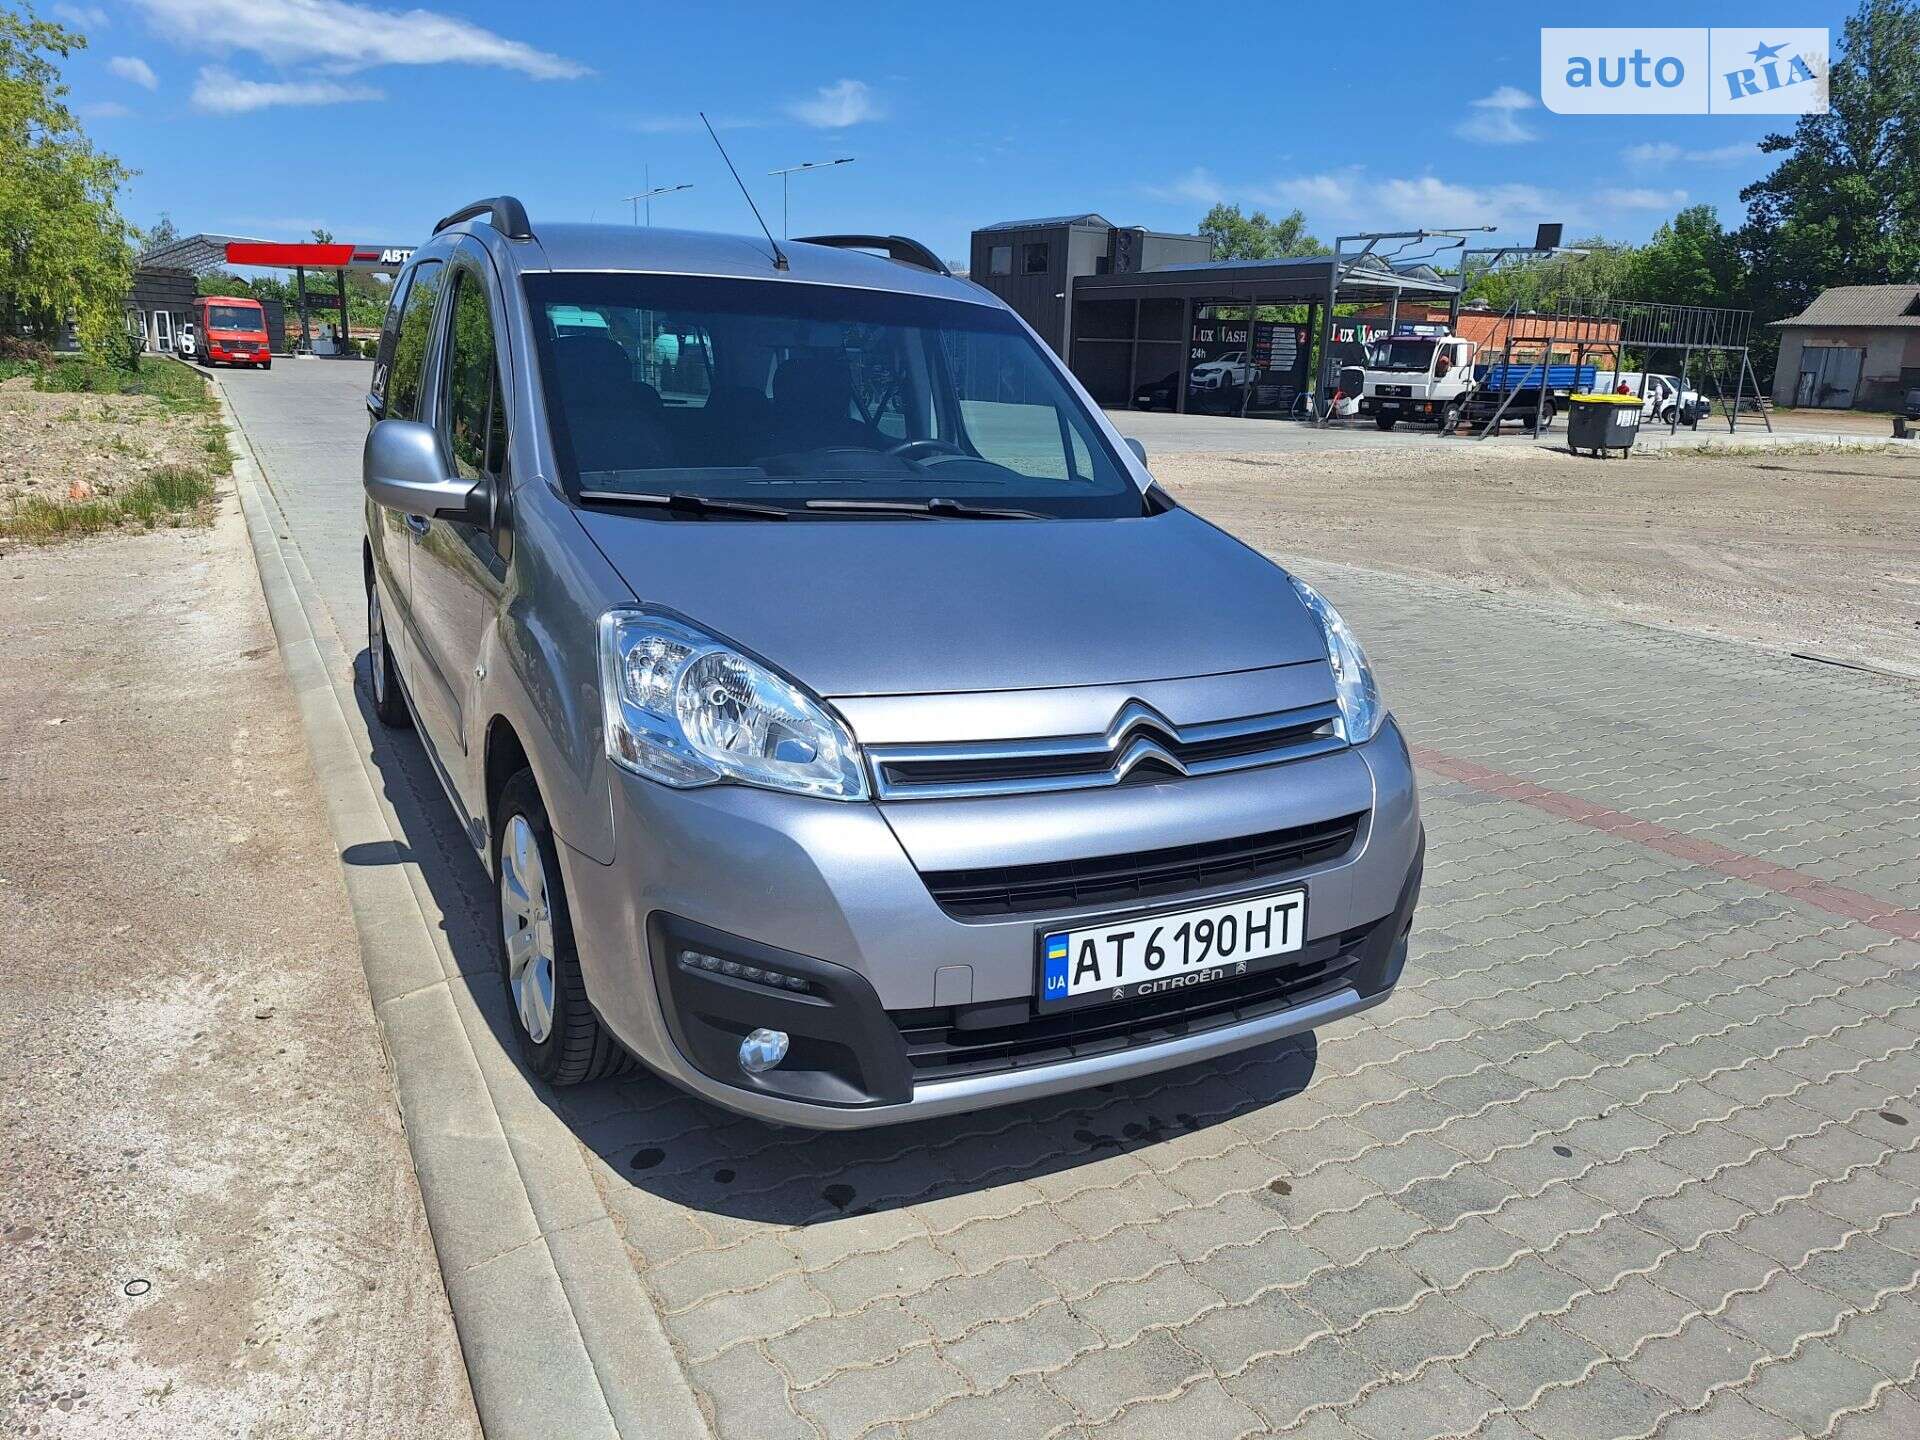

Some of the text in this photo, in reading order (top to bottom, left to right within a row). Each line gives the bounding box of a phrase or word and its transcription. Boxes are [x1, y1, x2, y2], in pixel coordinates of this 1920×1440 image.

[1073, 901, 1299, 986] AT 6190 HT
[1047, 976, 1066, 989] UA
